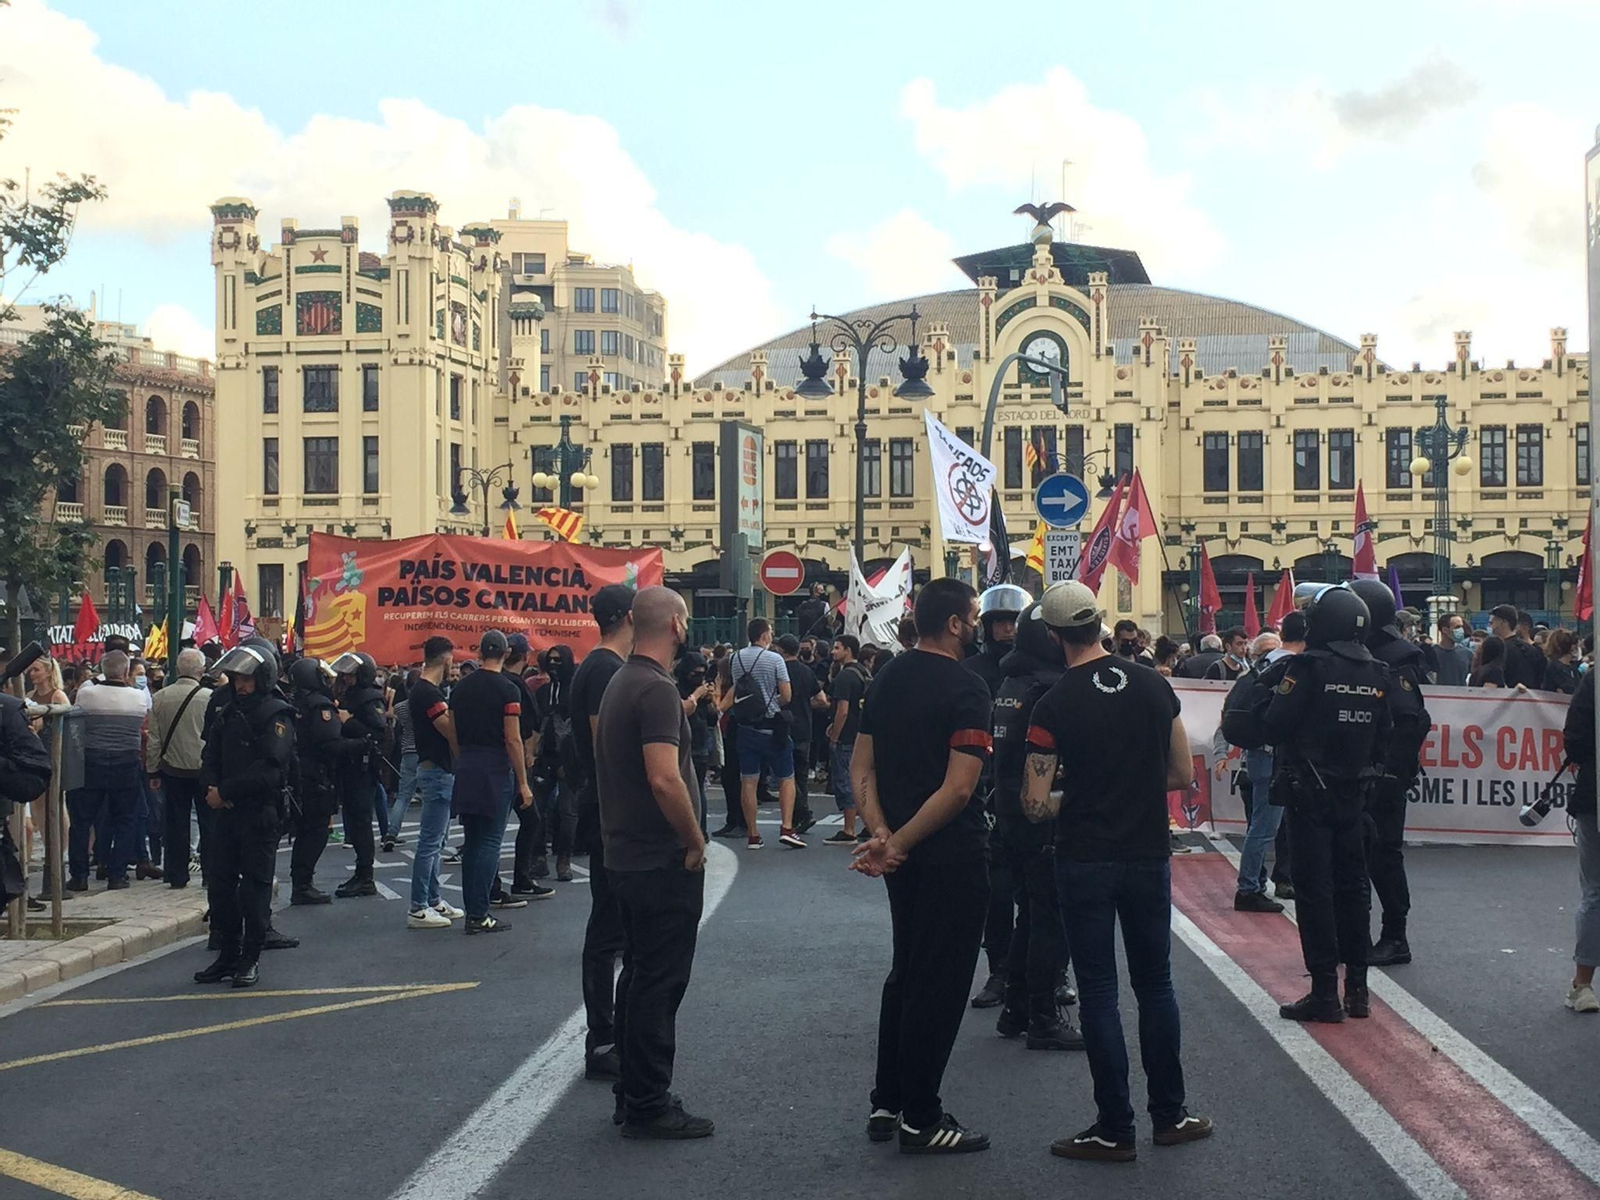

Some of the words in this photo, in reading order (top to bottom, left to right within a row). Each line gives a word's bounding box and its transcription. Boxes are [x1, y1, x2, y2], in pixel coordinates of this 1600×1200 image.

[1040, 410, 1059, 420] DEL
[1051, 546, 1074, 556] EMT
[399, 552, 457, 580] PAÍS
[1049, 558, 1075, 569] TAXI
[378, 579, 471, 608] PAÏSOS
[384, 611, 434, 621] RECUPEREM
[435, 611, 449, 619] ELS
[450, 612, 490, 622] CARRERS
[491, 614, 508, 624] PER
[509, 616, 547, 626] GUANYAR
[548, 618, 559, 626] LA
[560, 619, 600, 628] LLIBERTA
[535, 628, 582, 637] FEMINISME
[1324, 684, 1380, 698] POLICIA
[1420, 724, 1484, 768] ELS
[1496, 726, 1568, 772] CAR
[1462, 779, 1468, 805] I
[1477, 780, 1516, 806] LES
